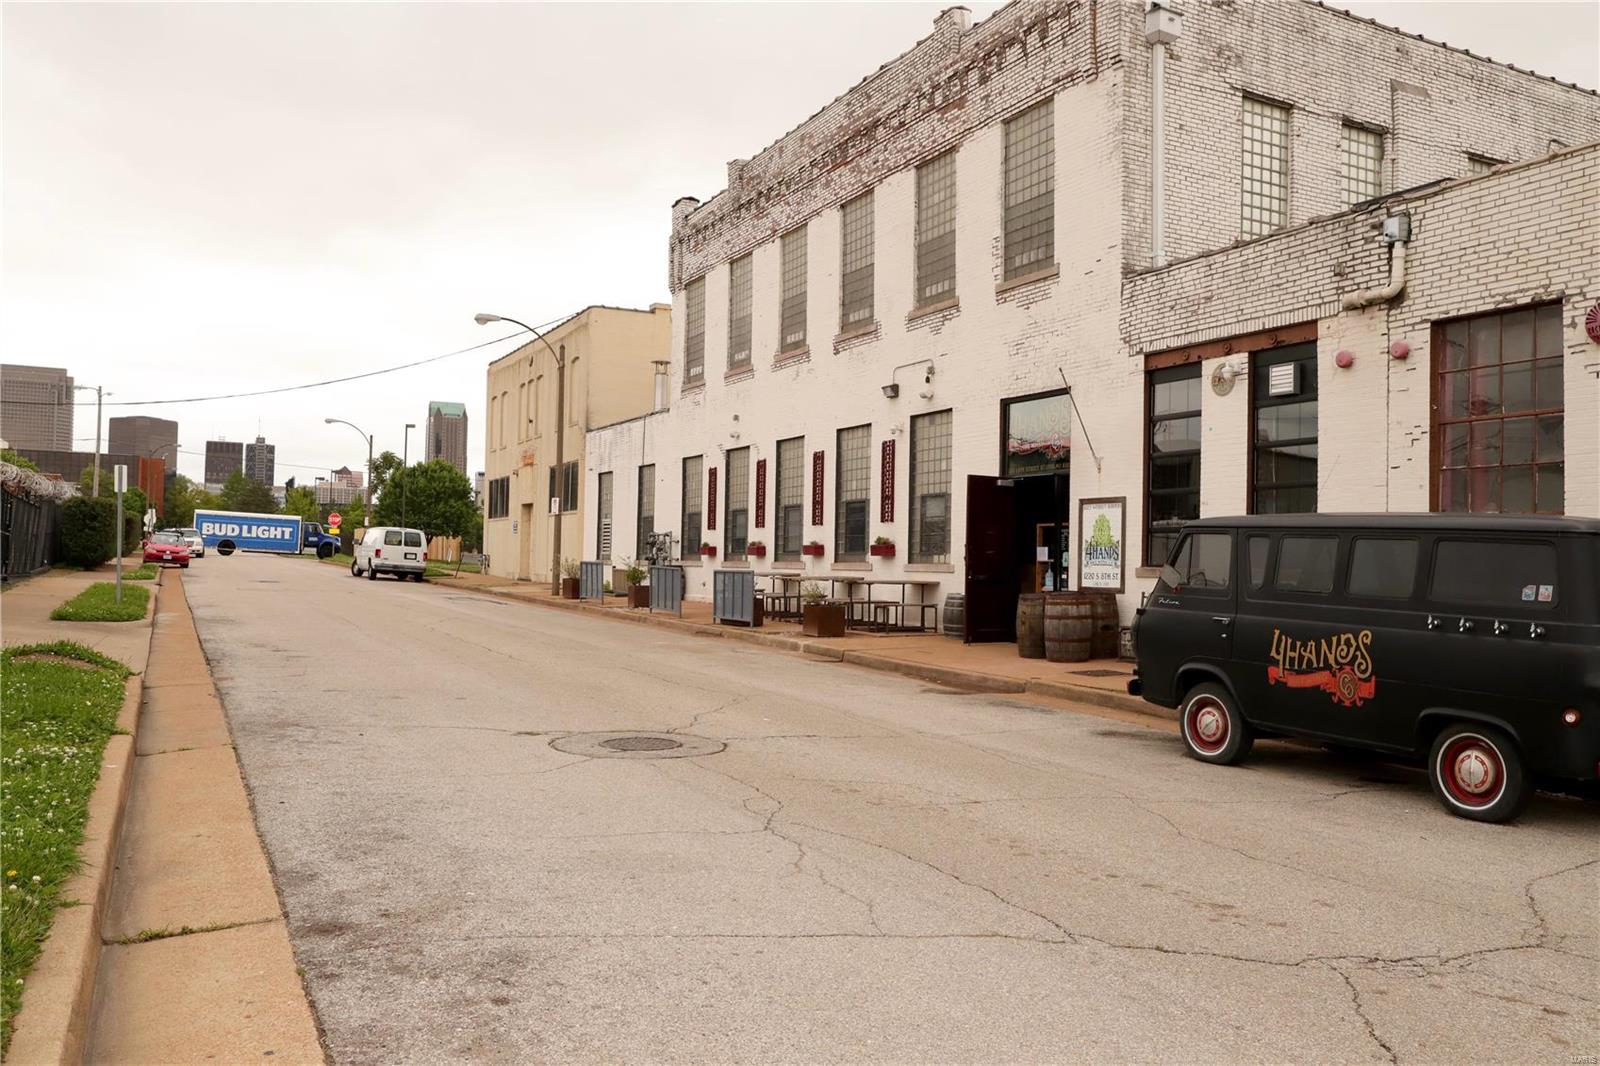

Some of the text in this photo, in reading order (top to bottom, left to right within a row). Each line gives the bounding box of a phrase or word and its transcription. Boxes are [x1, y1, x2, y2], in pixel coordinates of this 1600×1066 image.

[201, 522, 293, 540] BUD LIGHT
[1270, 629, 1372, 679] 4HANDS
